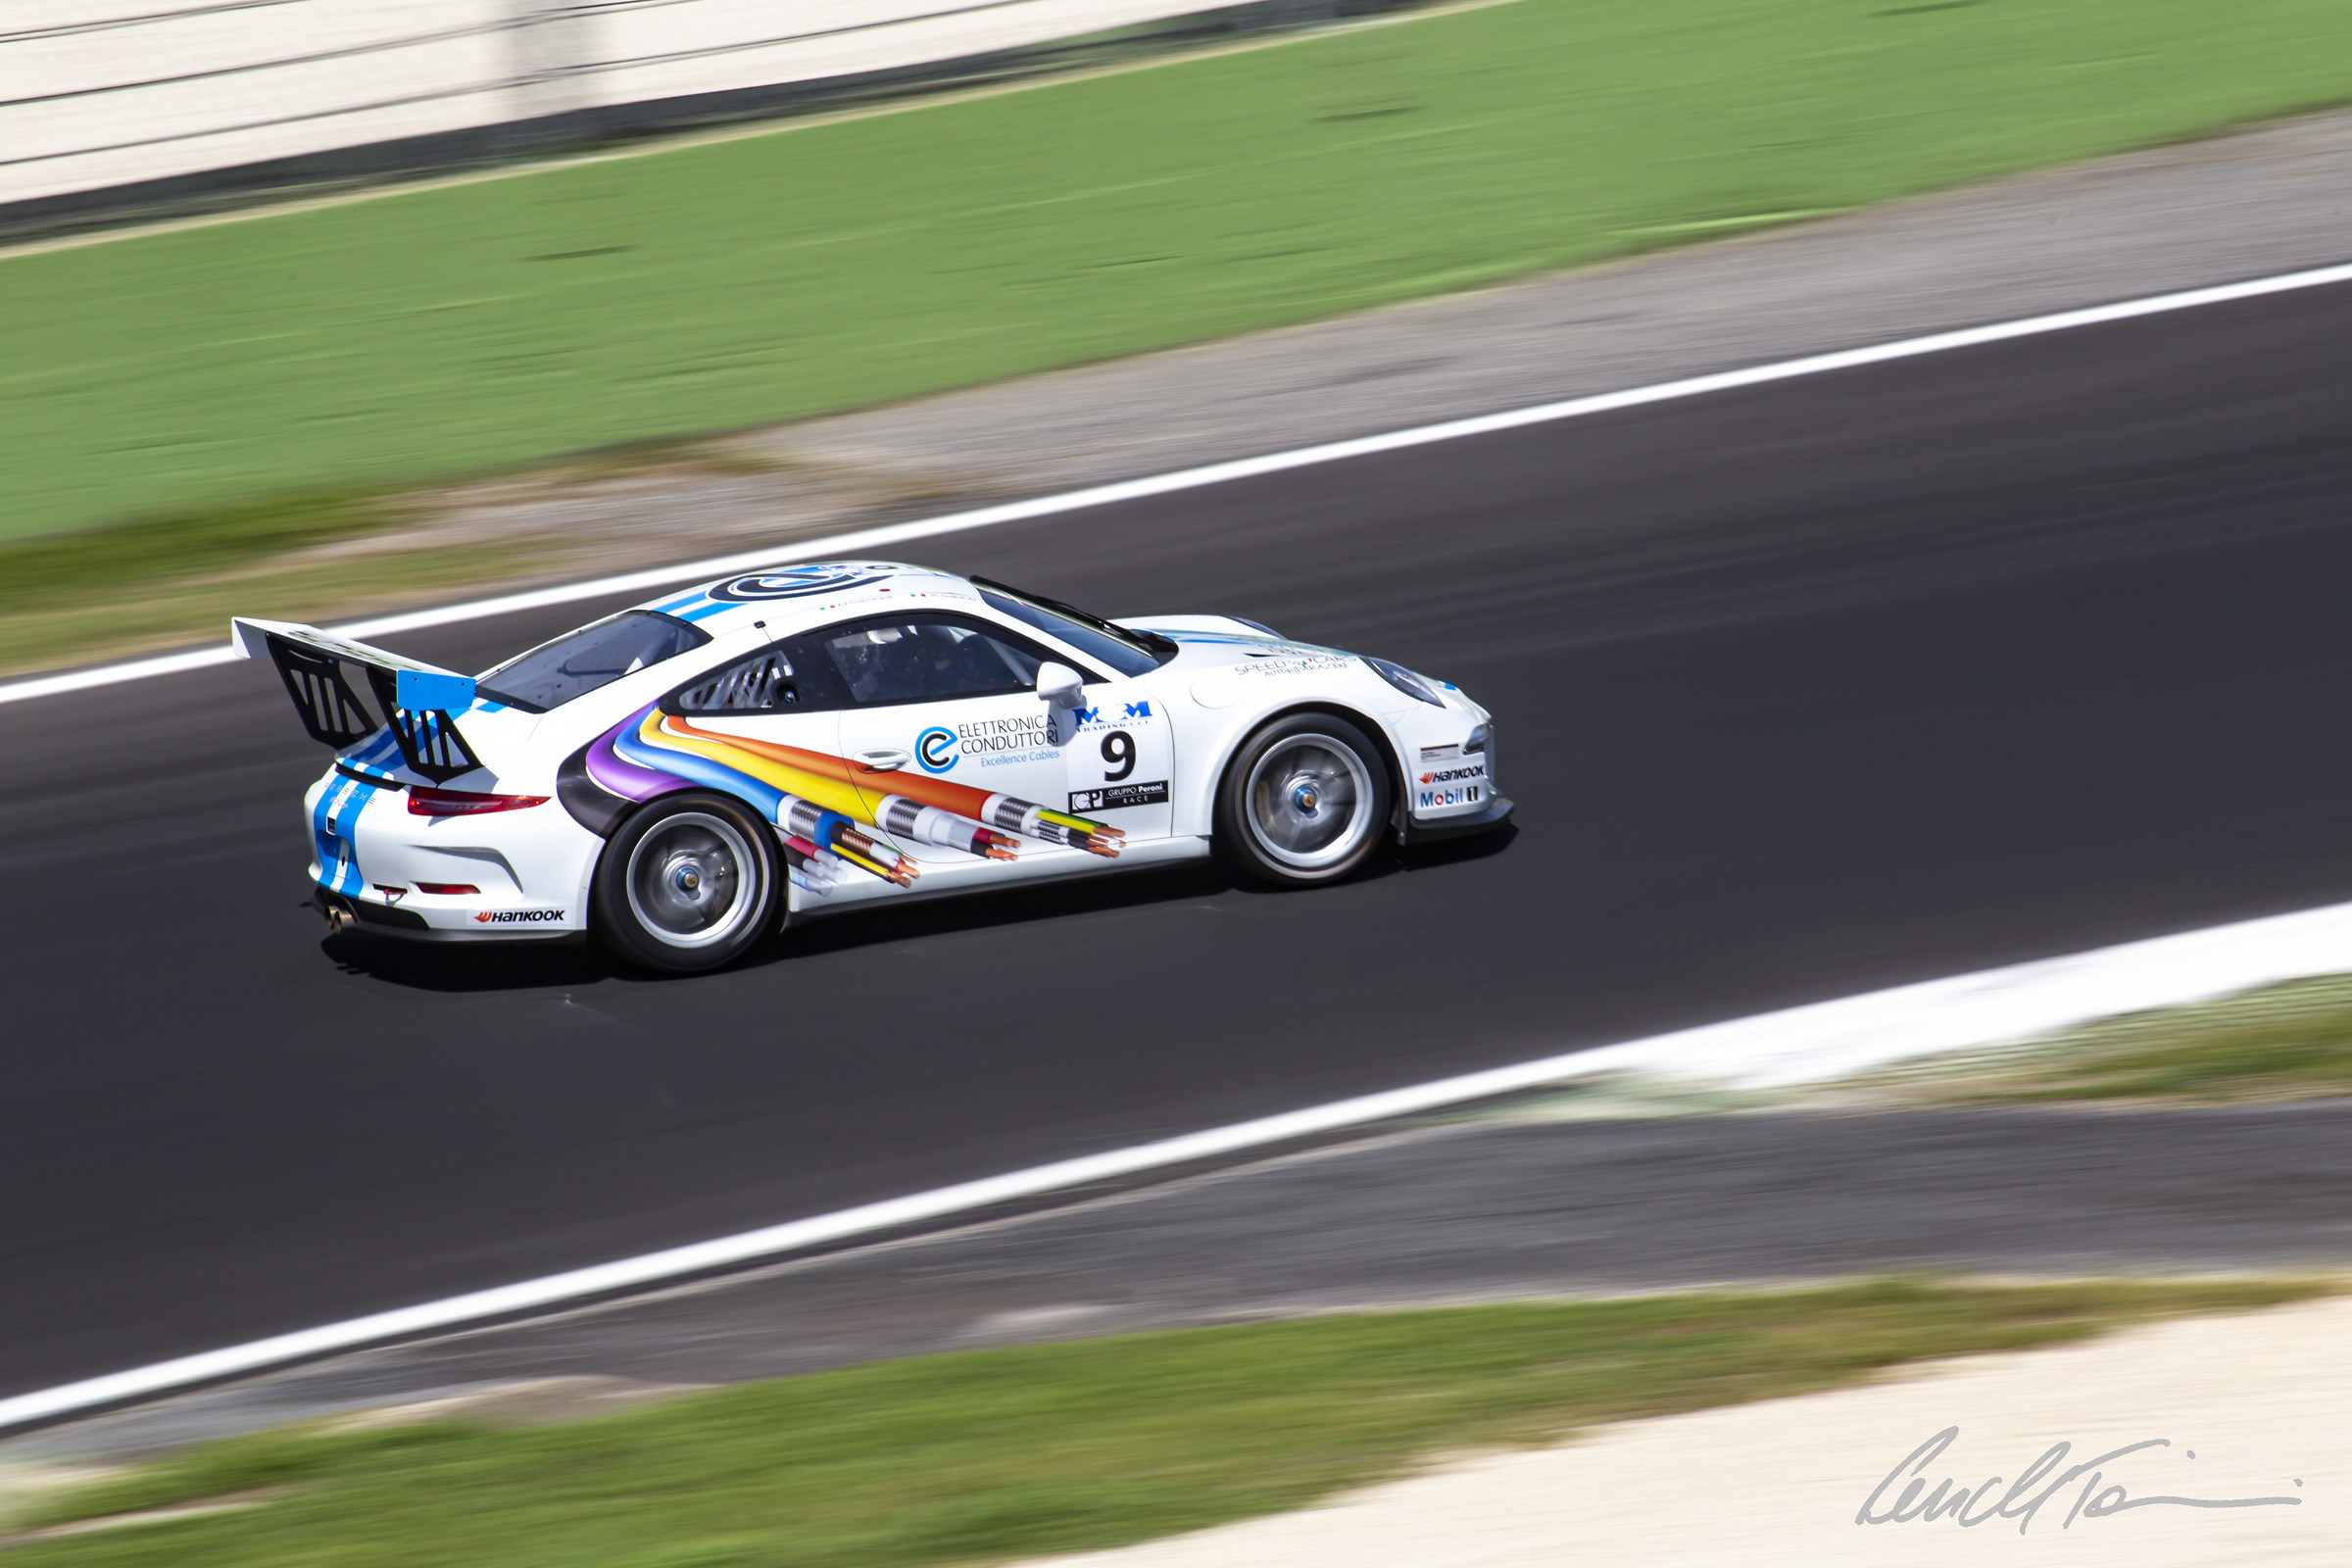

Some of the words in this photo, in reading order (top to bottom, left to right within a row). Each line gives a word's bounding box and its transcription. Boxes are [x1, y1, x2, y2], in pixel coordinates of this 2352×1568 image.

[1235, 660, 1287, 676] SPEED
[1072, 701, 1152, 725] MM
[958, 713, 1057, 738] ELETTRONICA
[960, 729, 1059, 755] CONDUTTORI
[980, 753, 1027, 767] Excellence
[1029, 749, 1060, 761] Cables
[1100, 730, 1137, 782] 9
[1107, 786, 1137, 797] GRUPPO
[1138, 783, 1163, 793] Peroni
[1122, 795, 1149, 805] RACE
[1420, 787, 1463, 808] Mobil
